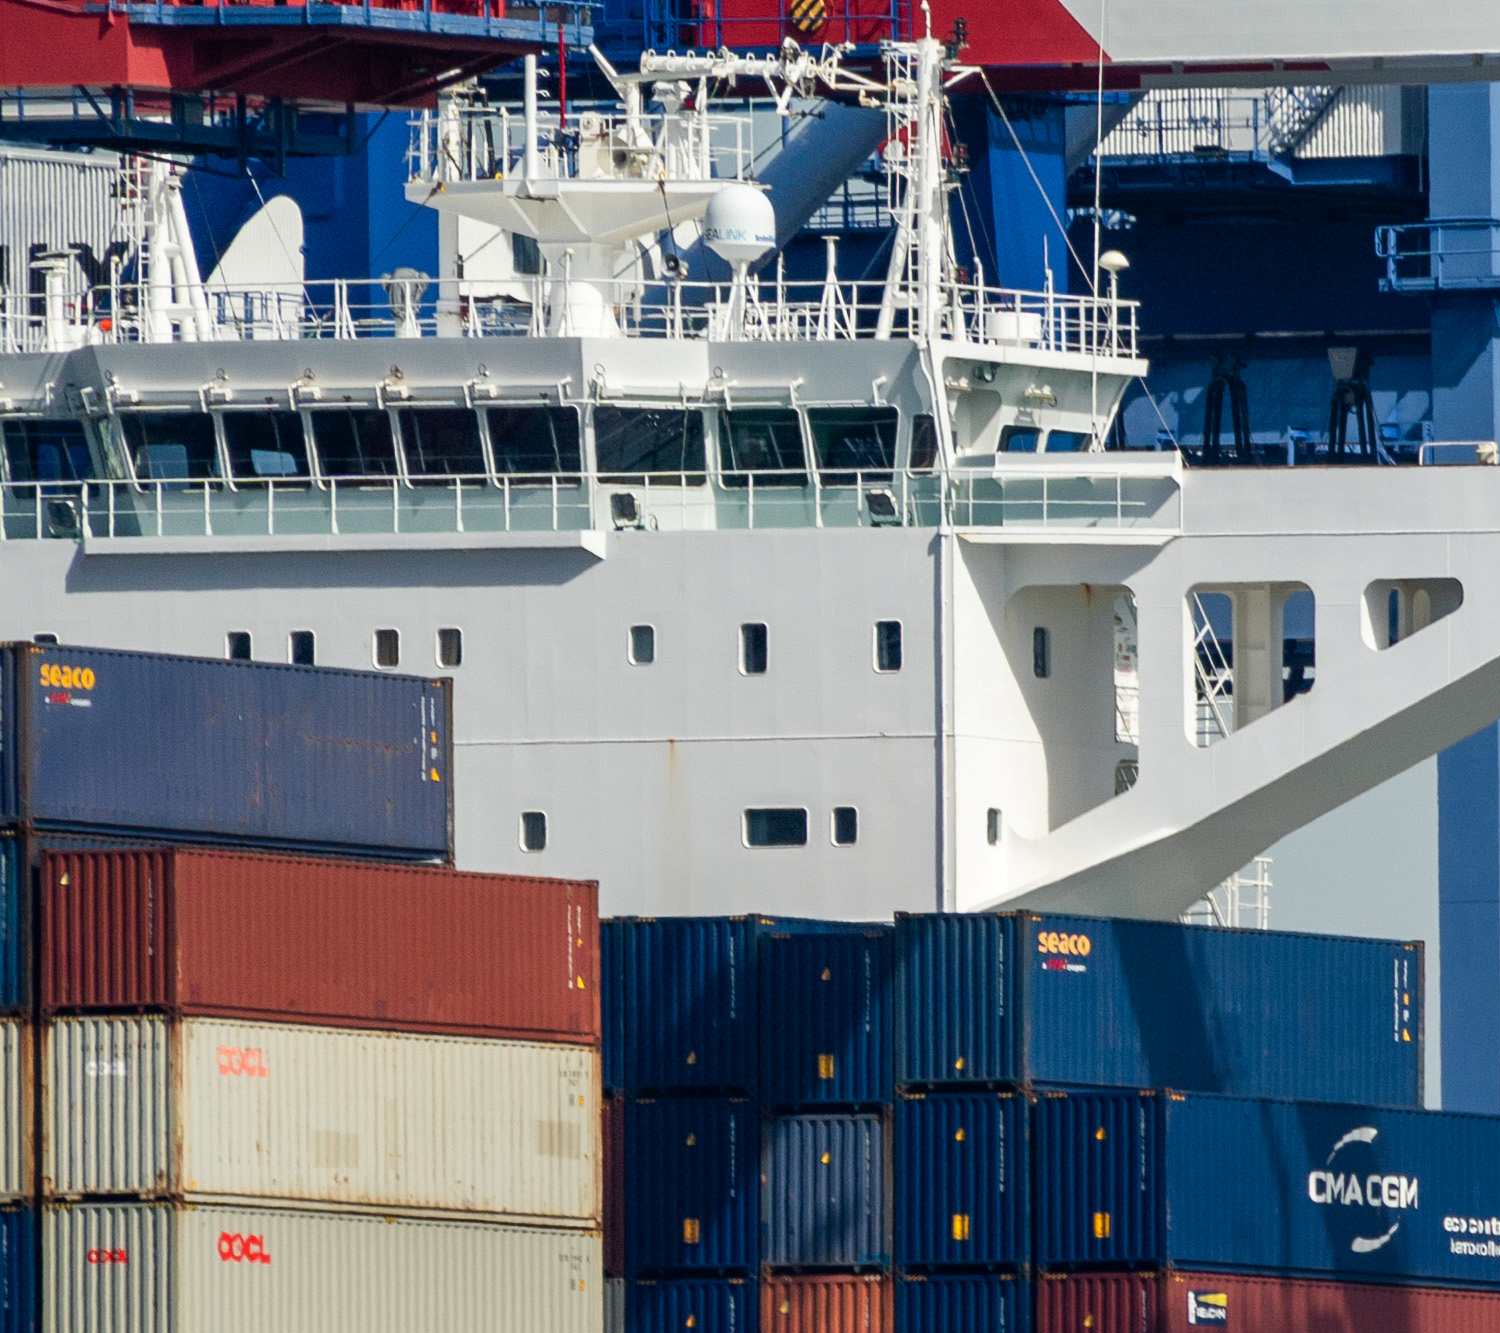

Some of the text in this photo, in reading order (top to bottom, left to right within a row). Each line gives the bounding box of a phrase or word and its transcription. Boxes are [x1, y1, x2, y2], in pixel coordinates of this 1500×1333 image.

[40, 663, 96, 690] seaco
[1038, 931, 1091, 957] seaco
[1308, 1170, 1419, 1210] CMA CGM
[217, 1231, 272, 1265] OOCL
